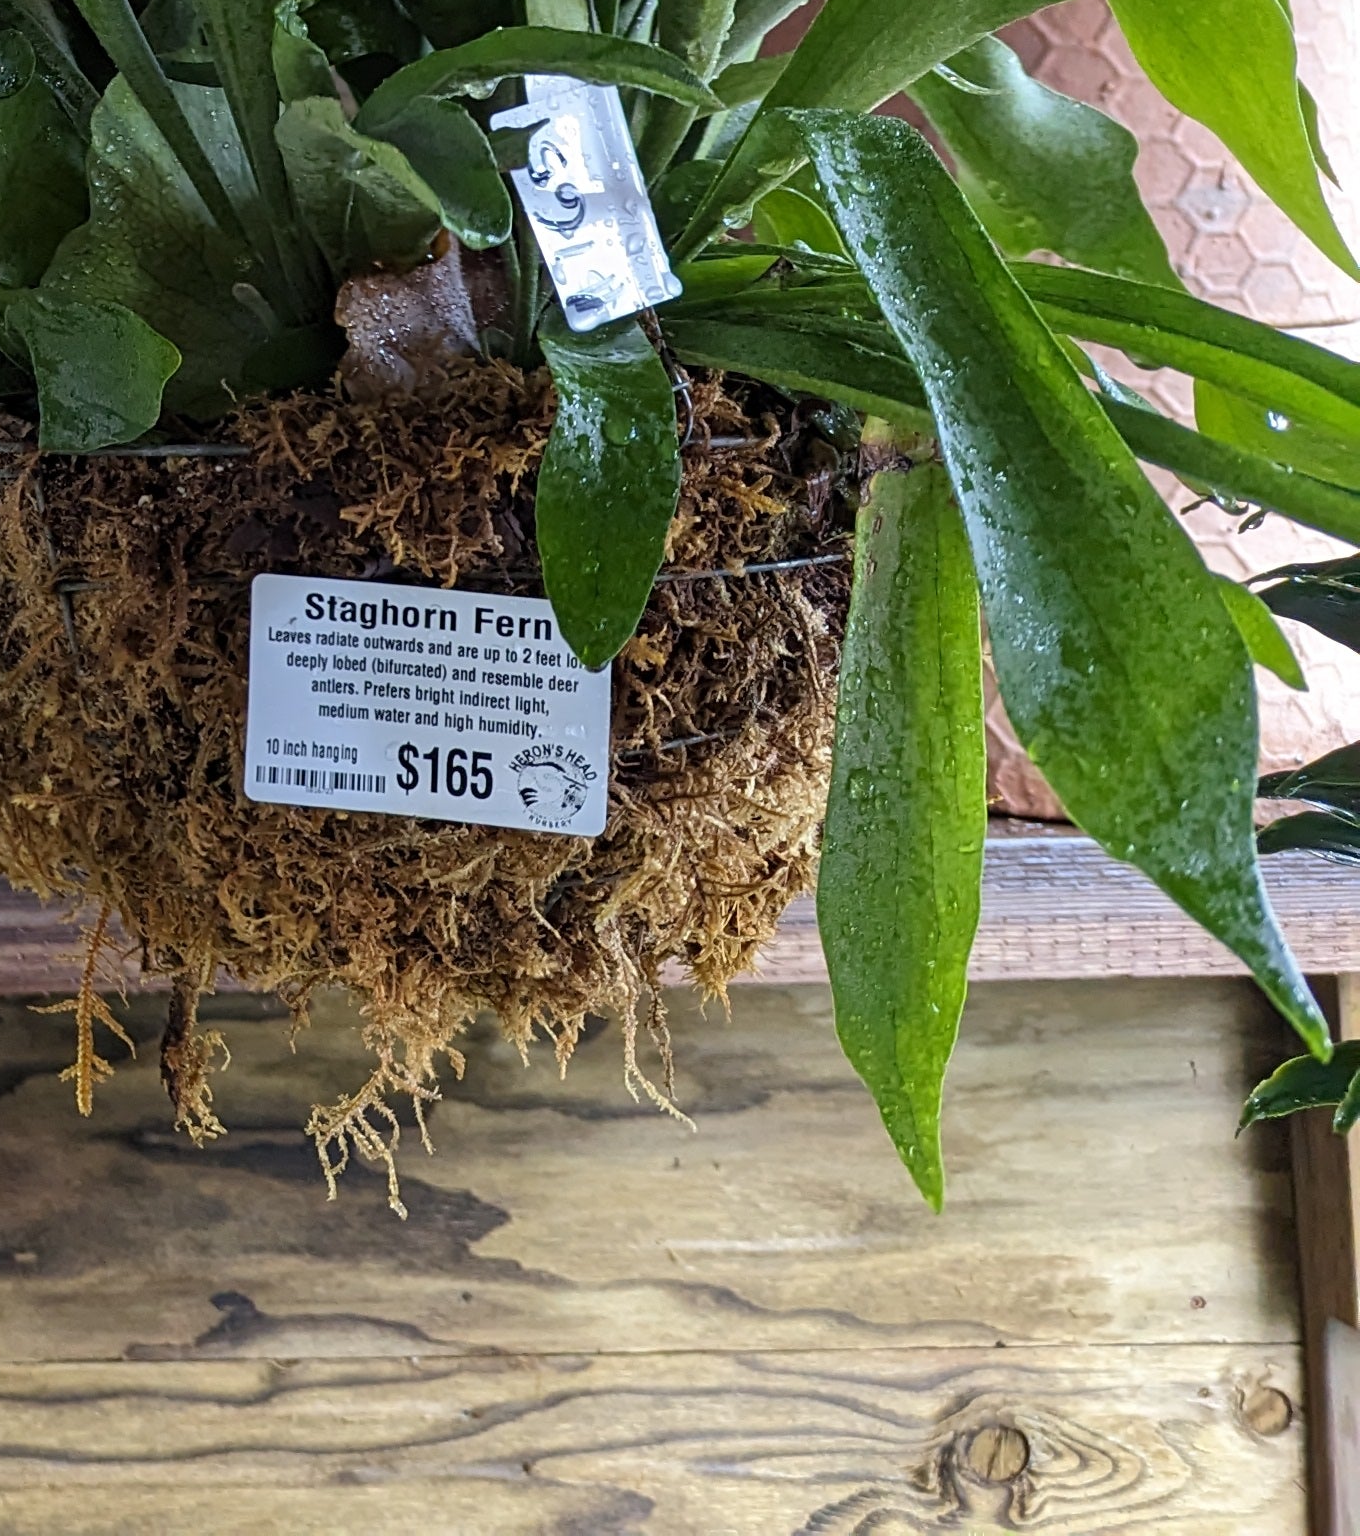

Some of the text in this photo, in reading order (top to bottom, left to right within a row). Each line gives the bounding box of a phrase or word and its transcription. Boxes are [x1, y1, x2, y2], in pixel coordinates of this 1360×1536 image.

[305, 592, 552, 640] Staghorn Fern
[268, 626, 582, 670] Leaves radiate outwards and are up to 2 feet lo
[286, 651, 579, 693] deeply lobed (bifurcated) and resemble deer
[311, 678, 549, 717] antlers. Prefers bright indirect light,
[318, 703, 543, 740] medium water and high humidity.
[266, 737, 358, 765] 10 inch hanging
[396, 741, 493, 800] $165
[508, 743, 598, 781] HERON'S HEAD
